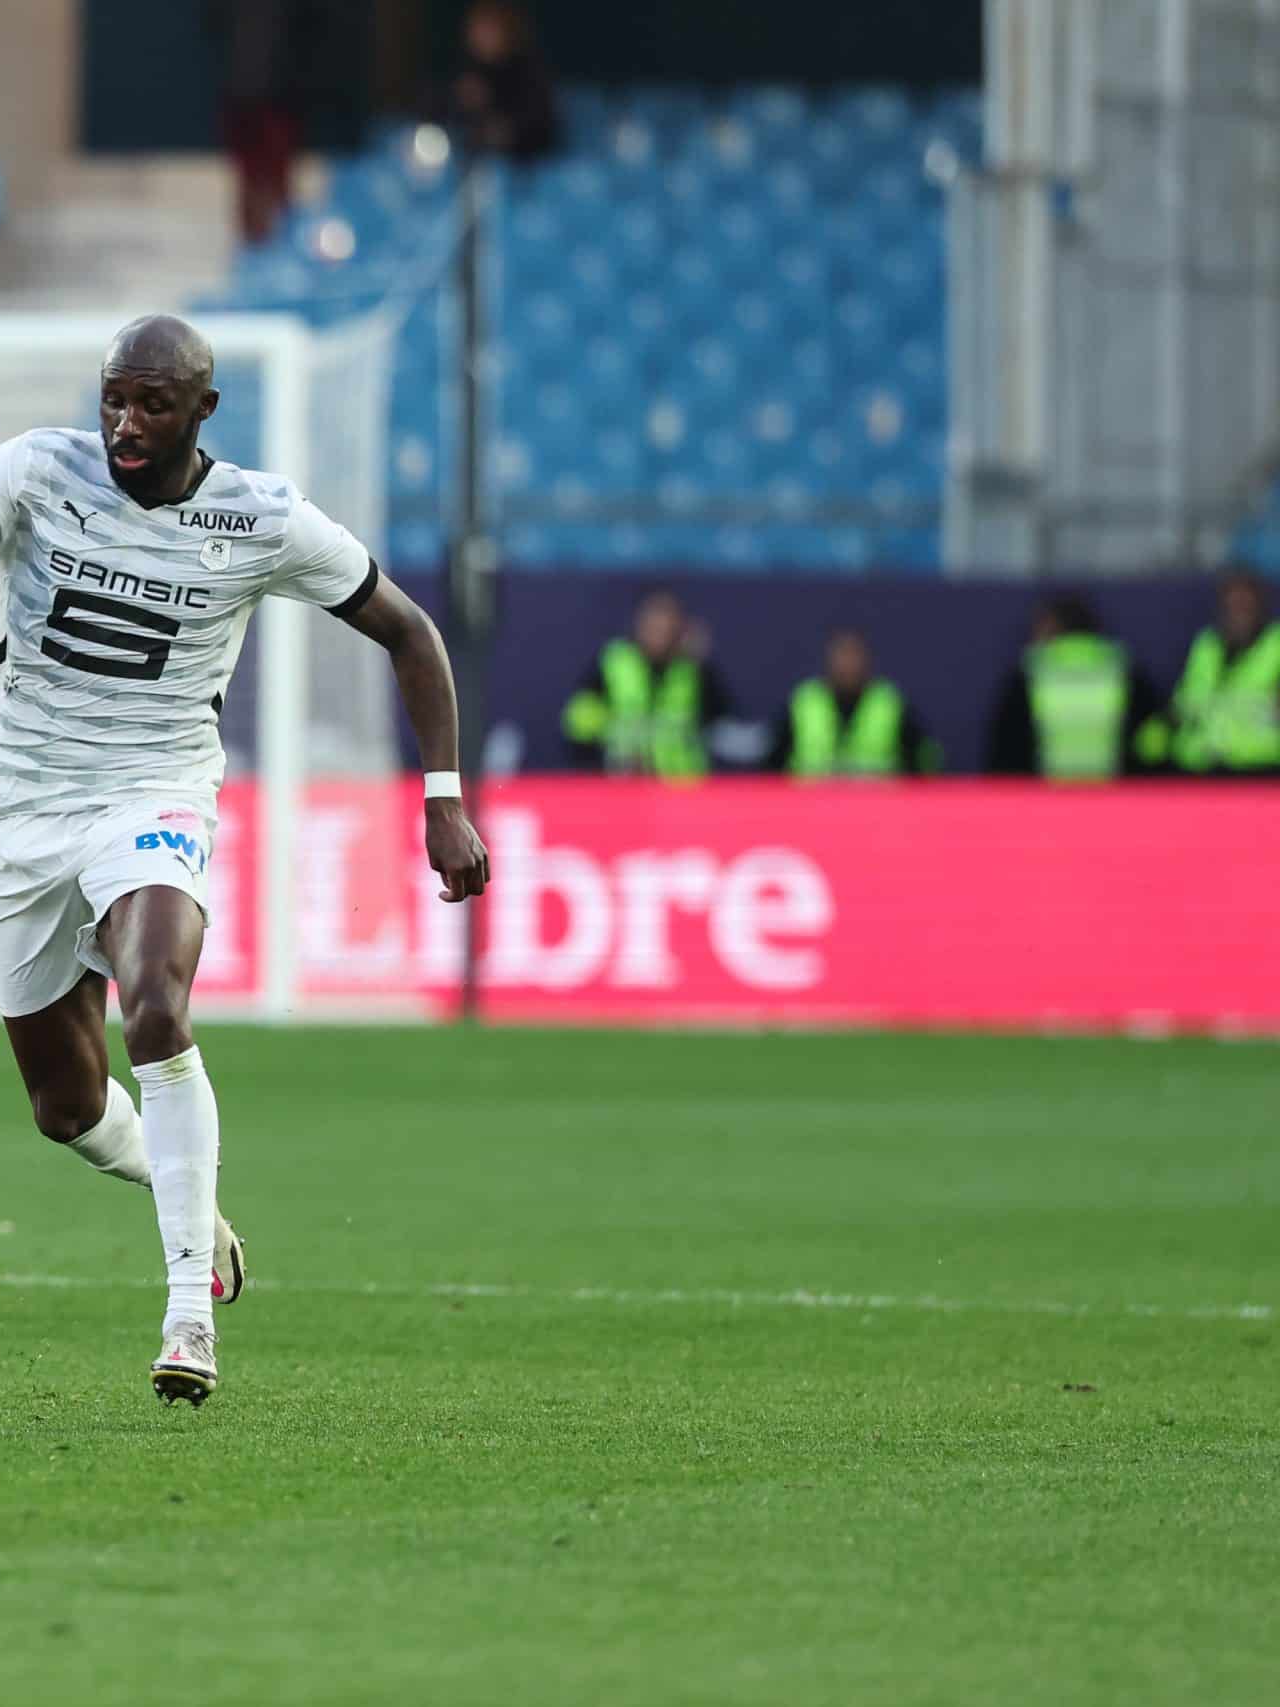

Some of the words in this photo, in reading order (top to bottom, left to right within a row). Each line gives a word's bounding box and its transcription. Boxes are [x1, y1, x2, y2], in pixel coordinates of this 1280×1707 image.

[179, 511, 258, 533] LAUNAY
[50, 550, 210, 609] SAMSIC
[299, 803, 833, 991] Libre
